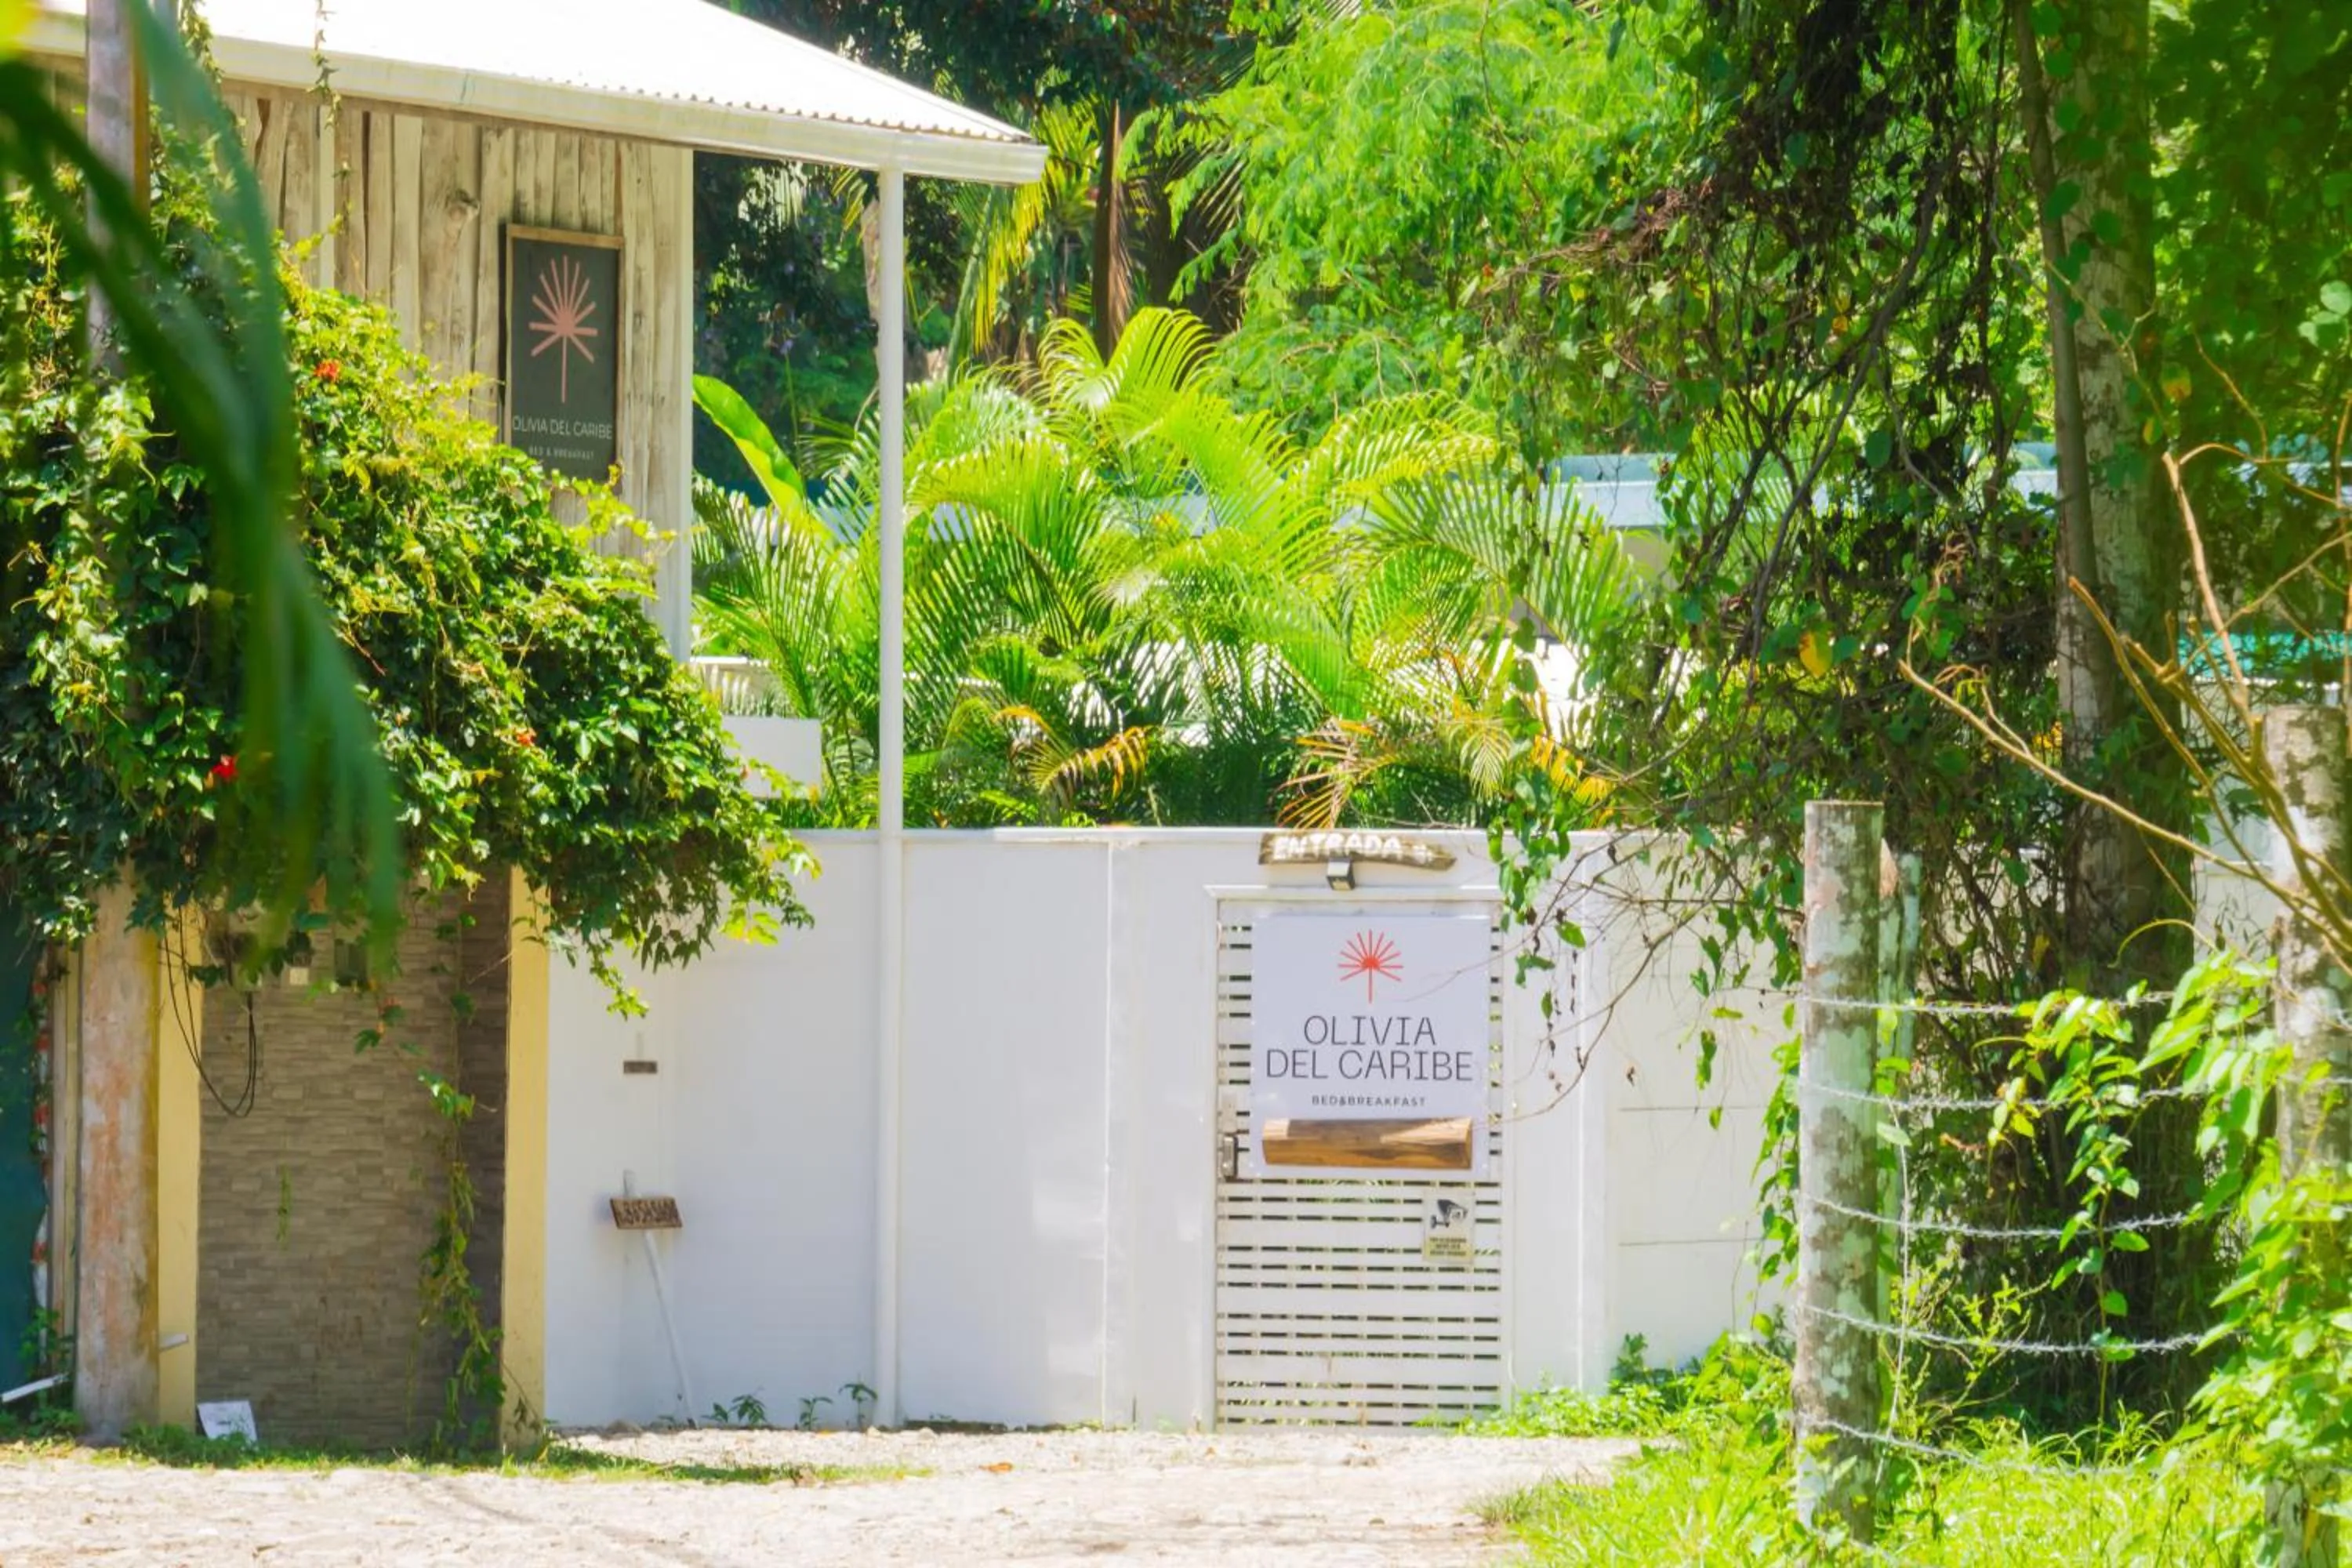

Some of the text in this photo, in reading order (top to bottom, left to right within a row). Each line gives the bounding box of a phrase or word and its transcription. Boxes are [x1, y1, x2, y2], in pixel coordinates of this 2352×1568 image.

[513, 416, 612, 440] OLIVIA DEL CARIBE
[1272, 832, 1403, 861] ENTRADA
[1303, 1015, 1437, 1046] OLIVIA
[1265, 1048, 1473, 1081] DEL CARIBE
[1311, 1094, 1426, 1107] BED&BREAKFAST
